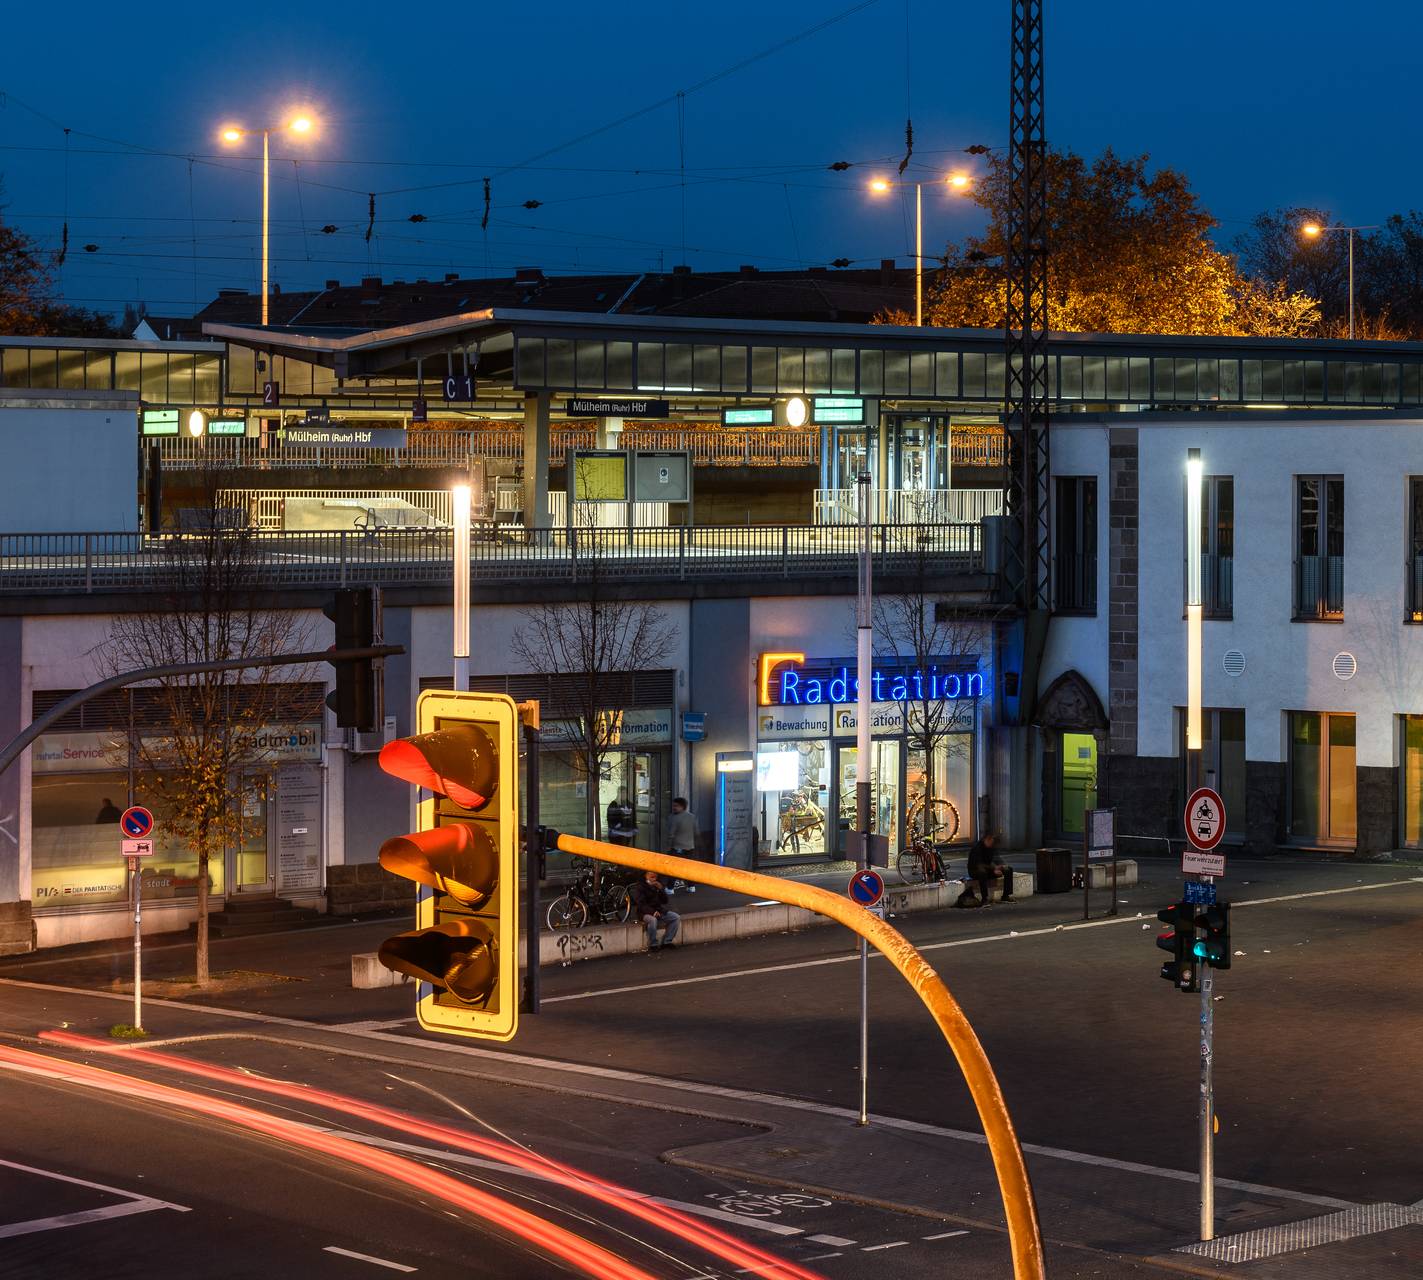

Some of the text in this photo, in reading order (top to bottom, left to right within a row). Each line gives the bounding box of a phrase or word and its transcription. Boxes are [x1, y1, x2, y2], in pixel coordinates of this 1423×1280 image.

[264, 383, 273, 403] 2
[446, 377, 472, 399] C 1
[573, 401, 648, 413] Mülheim (Ruhr) Hbf
[288, 431, 372, 443] Mülheim (Ruhr) Hbf
[782, 665, 984, 704] Radtation
[776, 719, 828, 732] Bewachung
